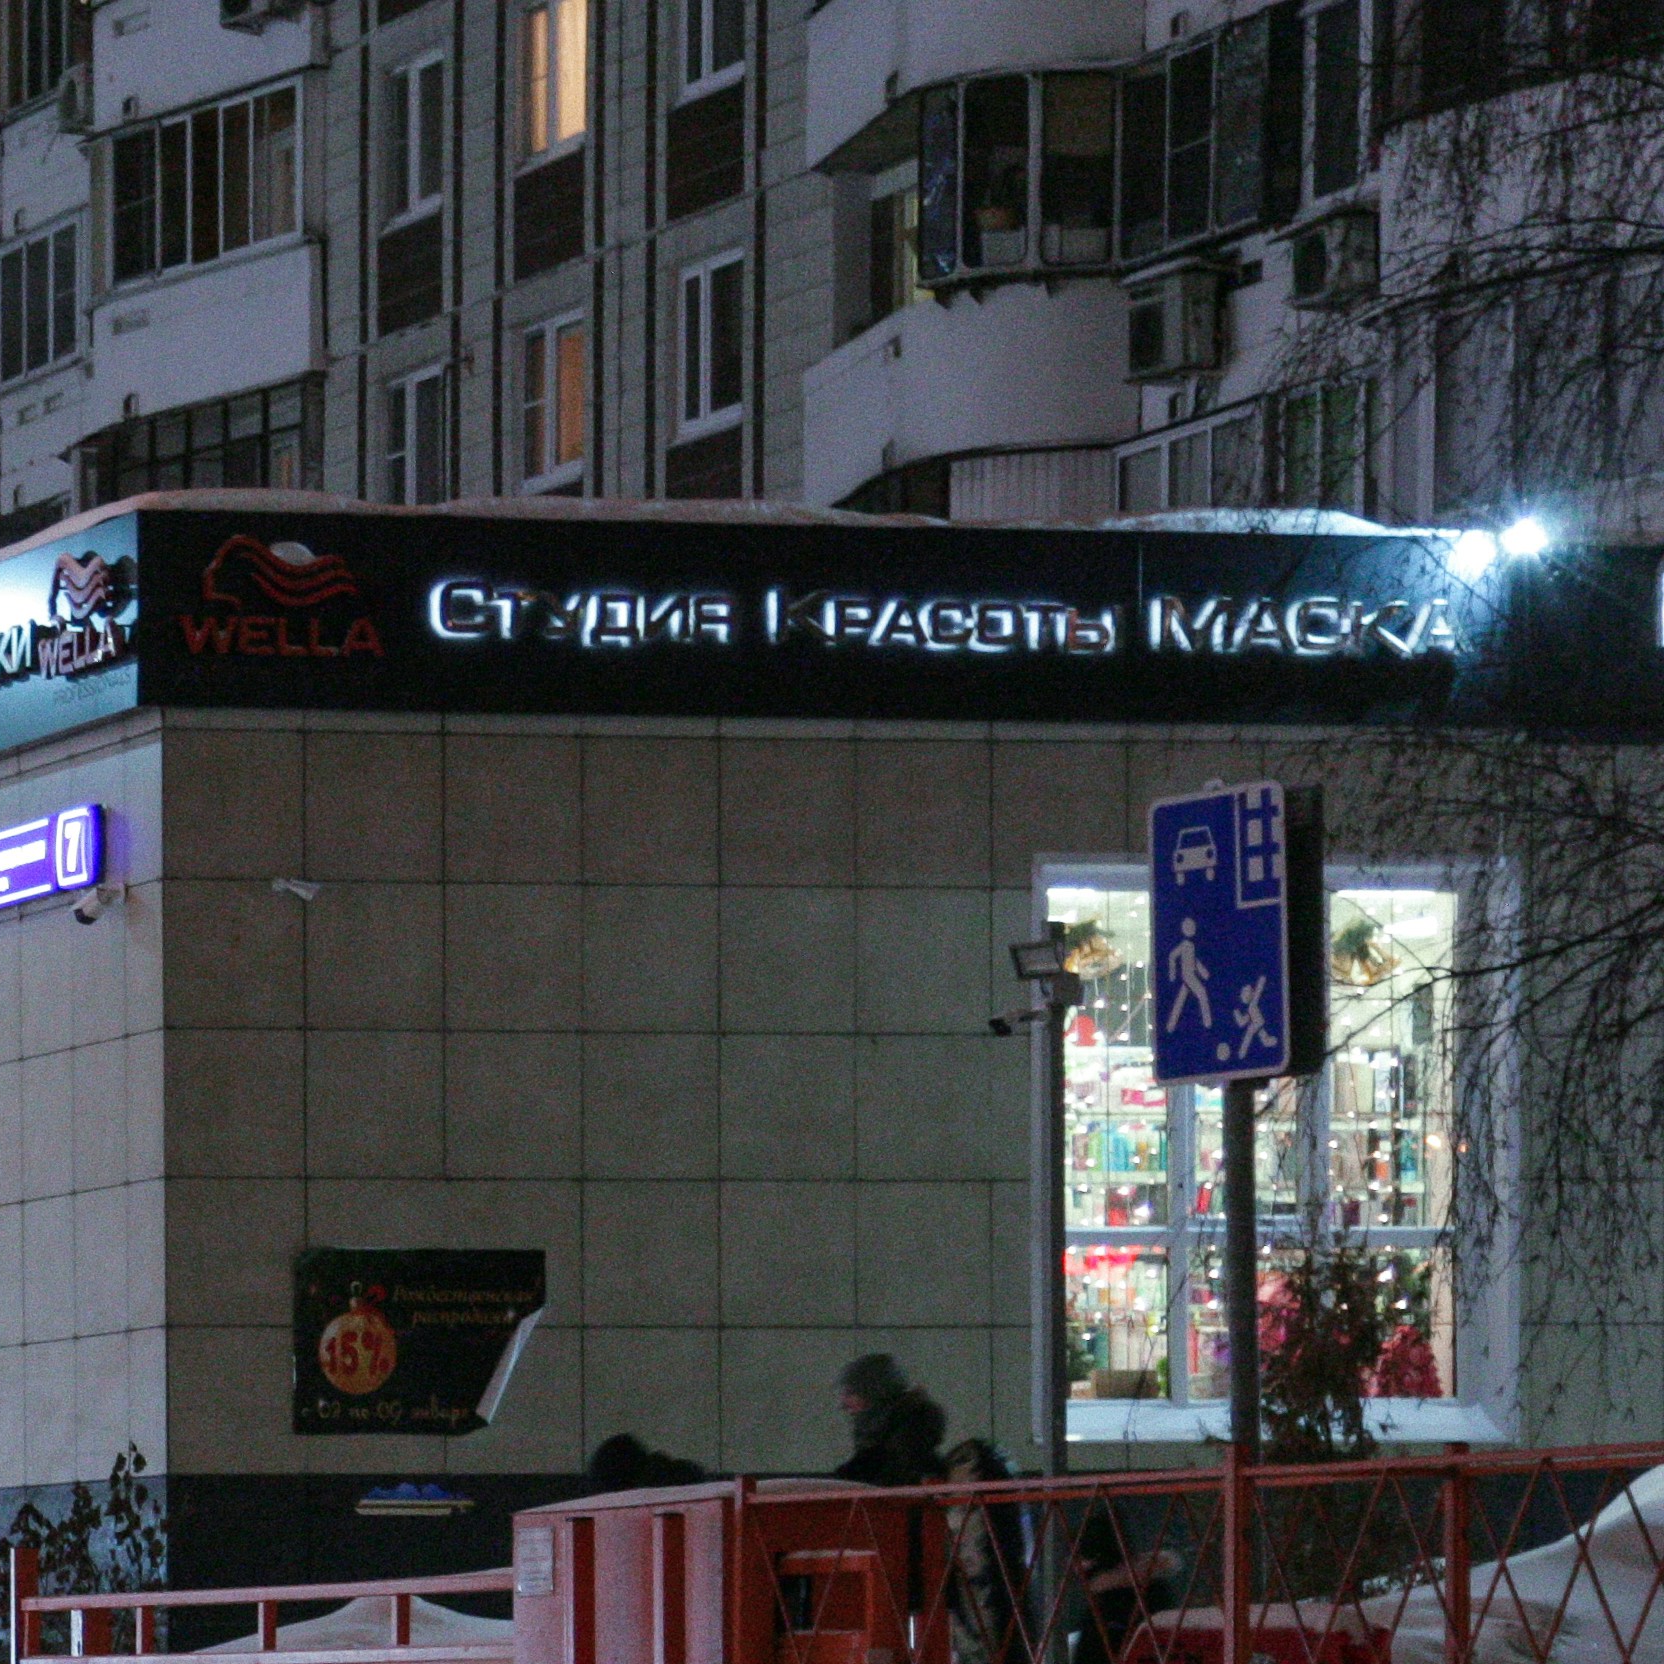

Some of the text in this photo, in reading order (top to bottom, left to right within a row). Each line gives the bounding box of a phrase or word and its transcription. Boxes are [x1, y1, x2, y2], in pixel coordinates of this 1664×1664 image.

[37, 616, 118, 679] WELLA
[179, 614, 384, 658] WELLA
[325, 1331, 393, 1376] 15%
